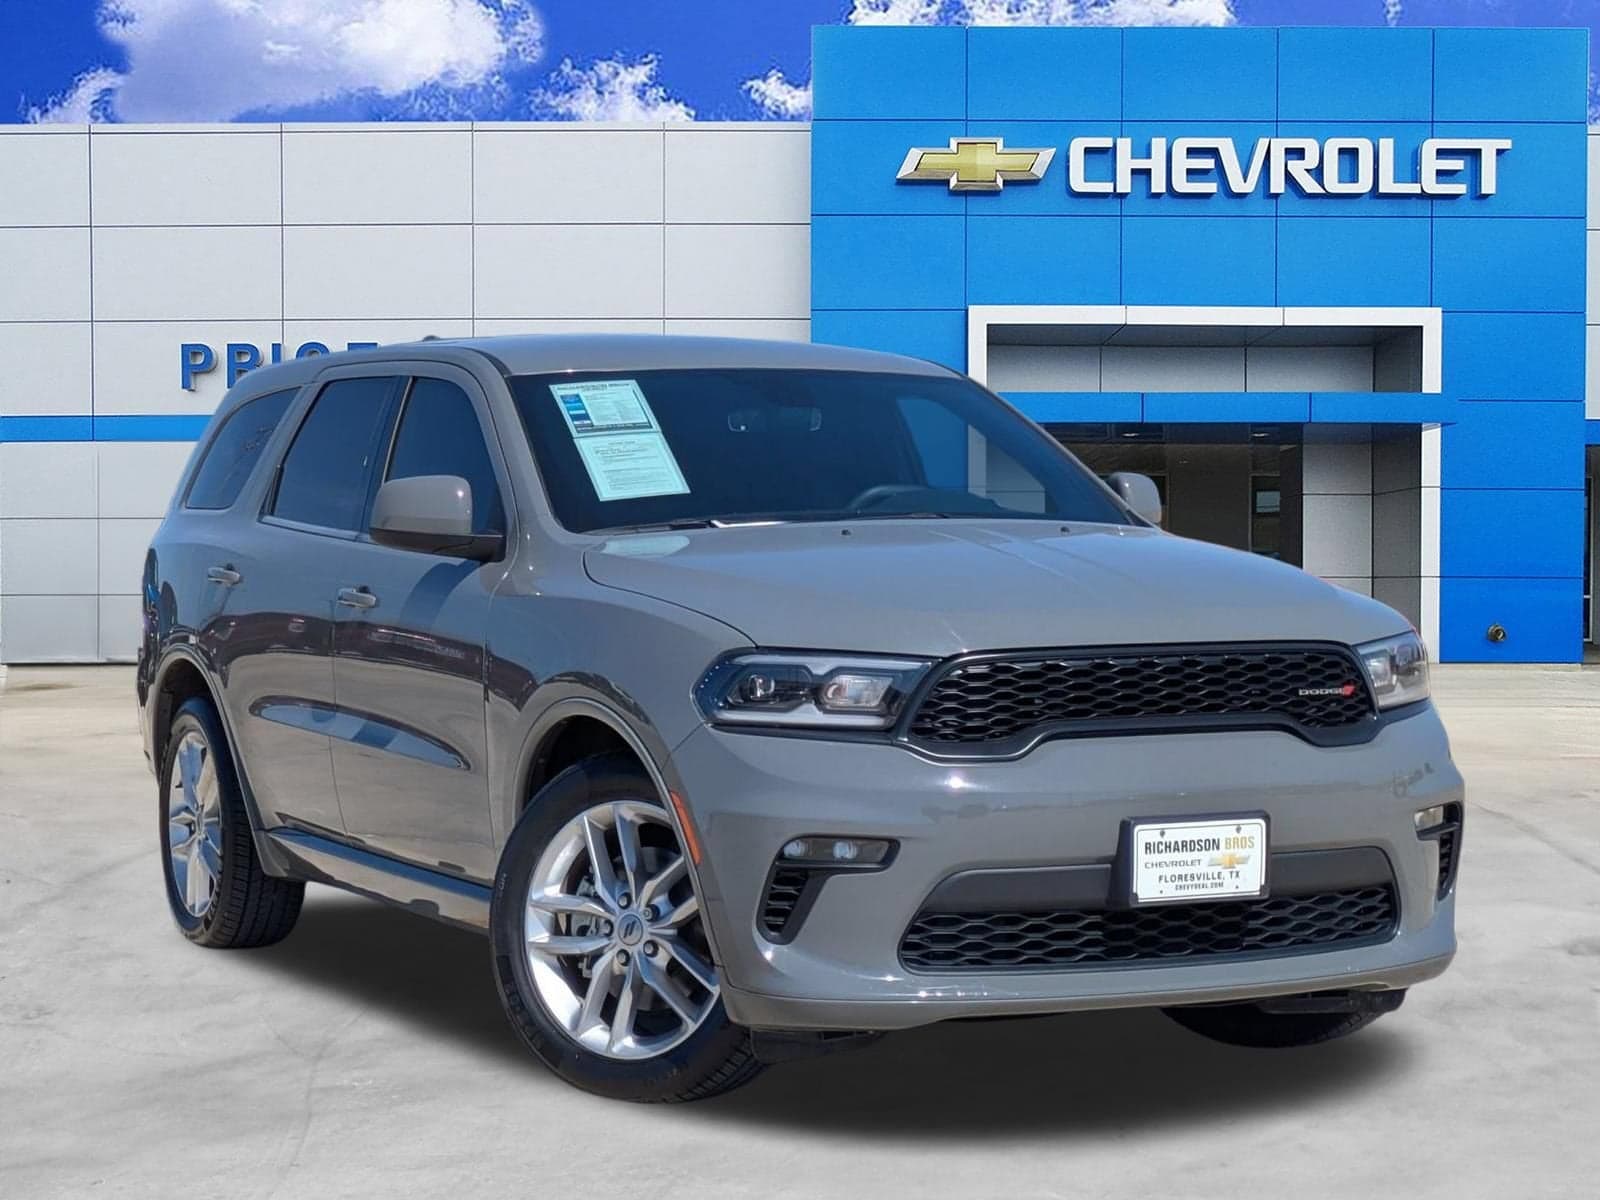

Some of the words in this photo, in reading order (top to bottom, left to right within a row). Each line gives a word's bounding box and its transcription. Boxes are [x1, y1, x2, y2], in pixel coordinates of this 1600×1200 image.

[1068, 136, 1513, 196] CHEVROLET
[1144, 838, 1220, 854] RICHARDSON
[1224, 836, 1255, 850] BROS
[1144, 859, 1202, 869] CHEVROLET
[1158, 871, 1225, 883] FLORESVILLE,
[1229, 870, 1240, 879] TX
